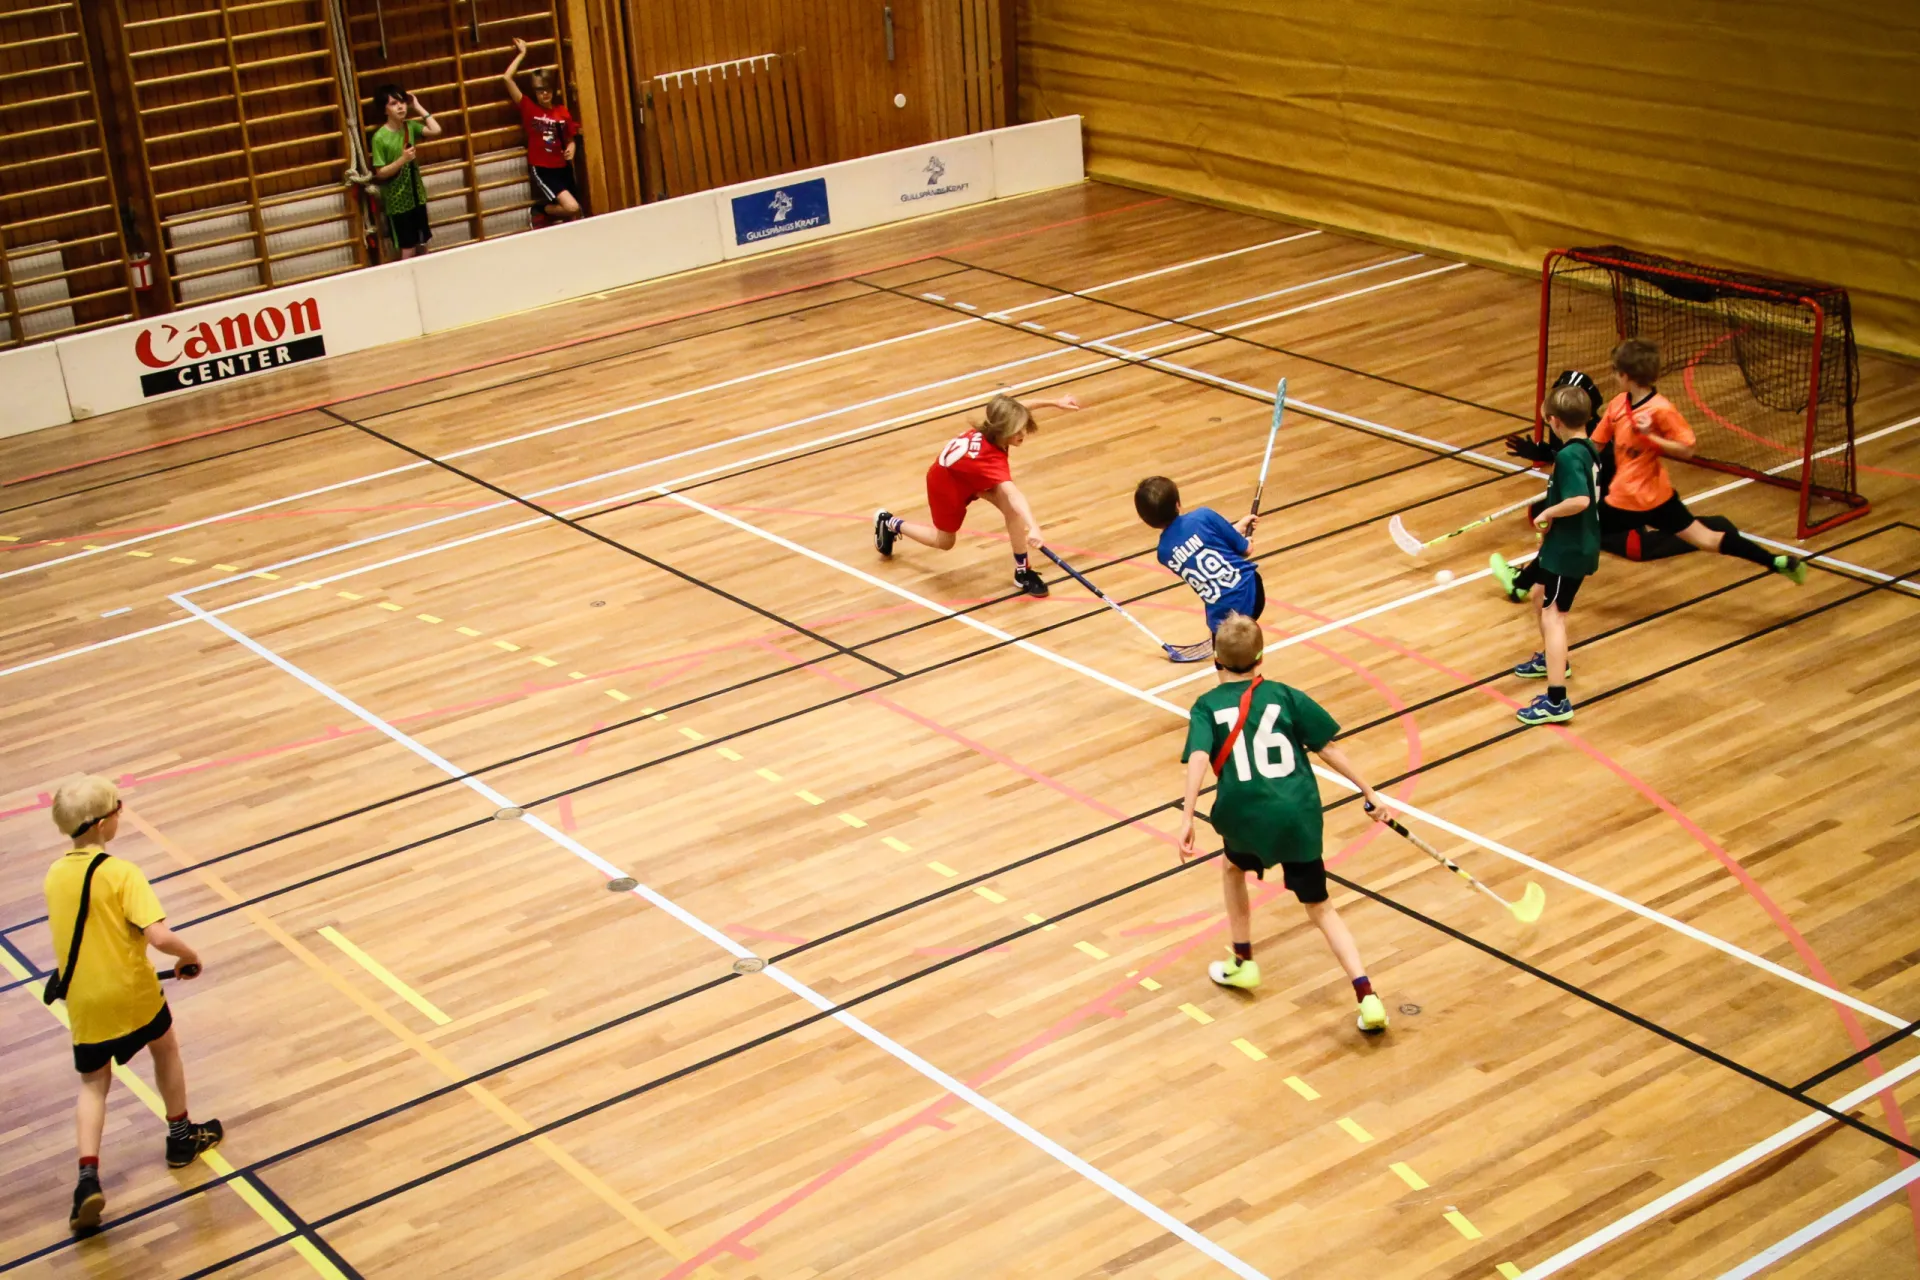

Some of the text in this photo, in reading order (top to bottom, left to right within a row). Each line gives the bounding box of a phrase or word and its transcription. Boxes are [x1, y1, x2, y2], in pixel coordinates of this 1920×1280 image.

[794, 216, 819, 229] KRAFT
[135, 297, 321, 368] Canon
[178, 346, 292, 386] CENTER
[1167, 533, 1204, 572] SJÖLIN
[1213, 703, 1296, 782] 16
